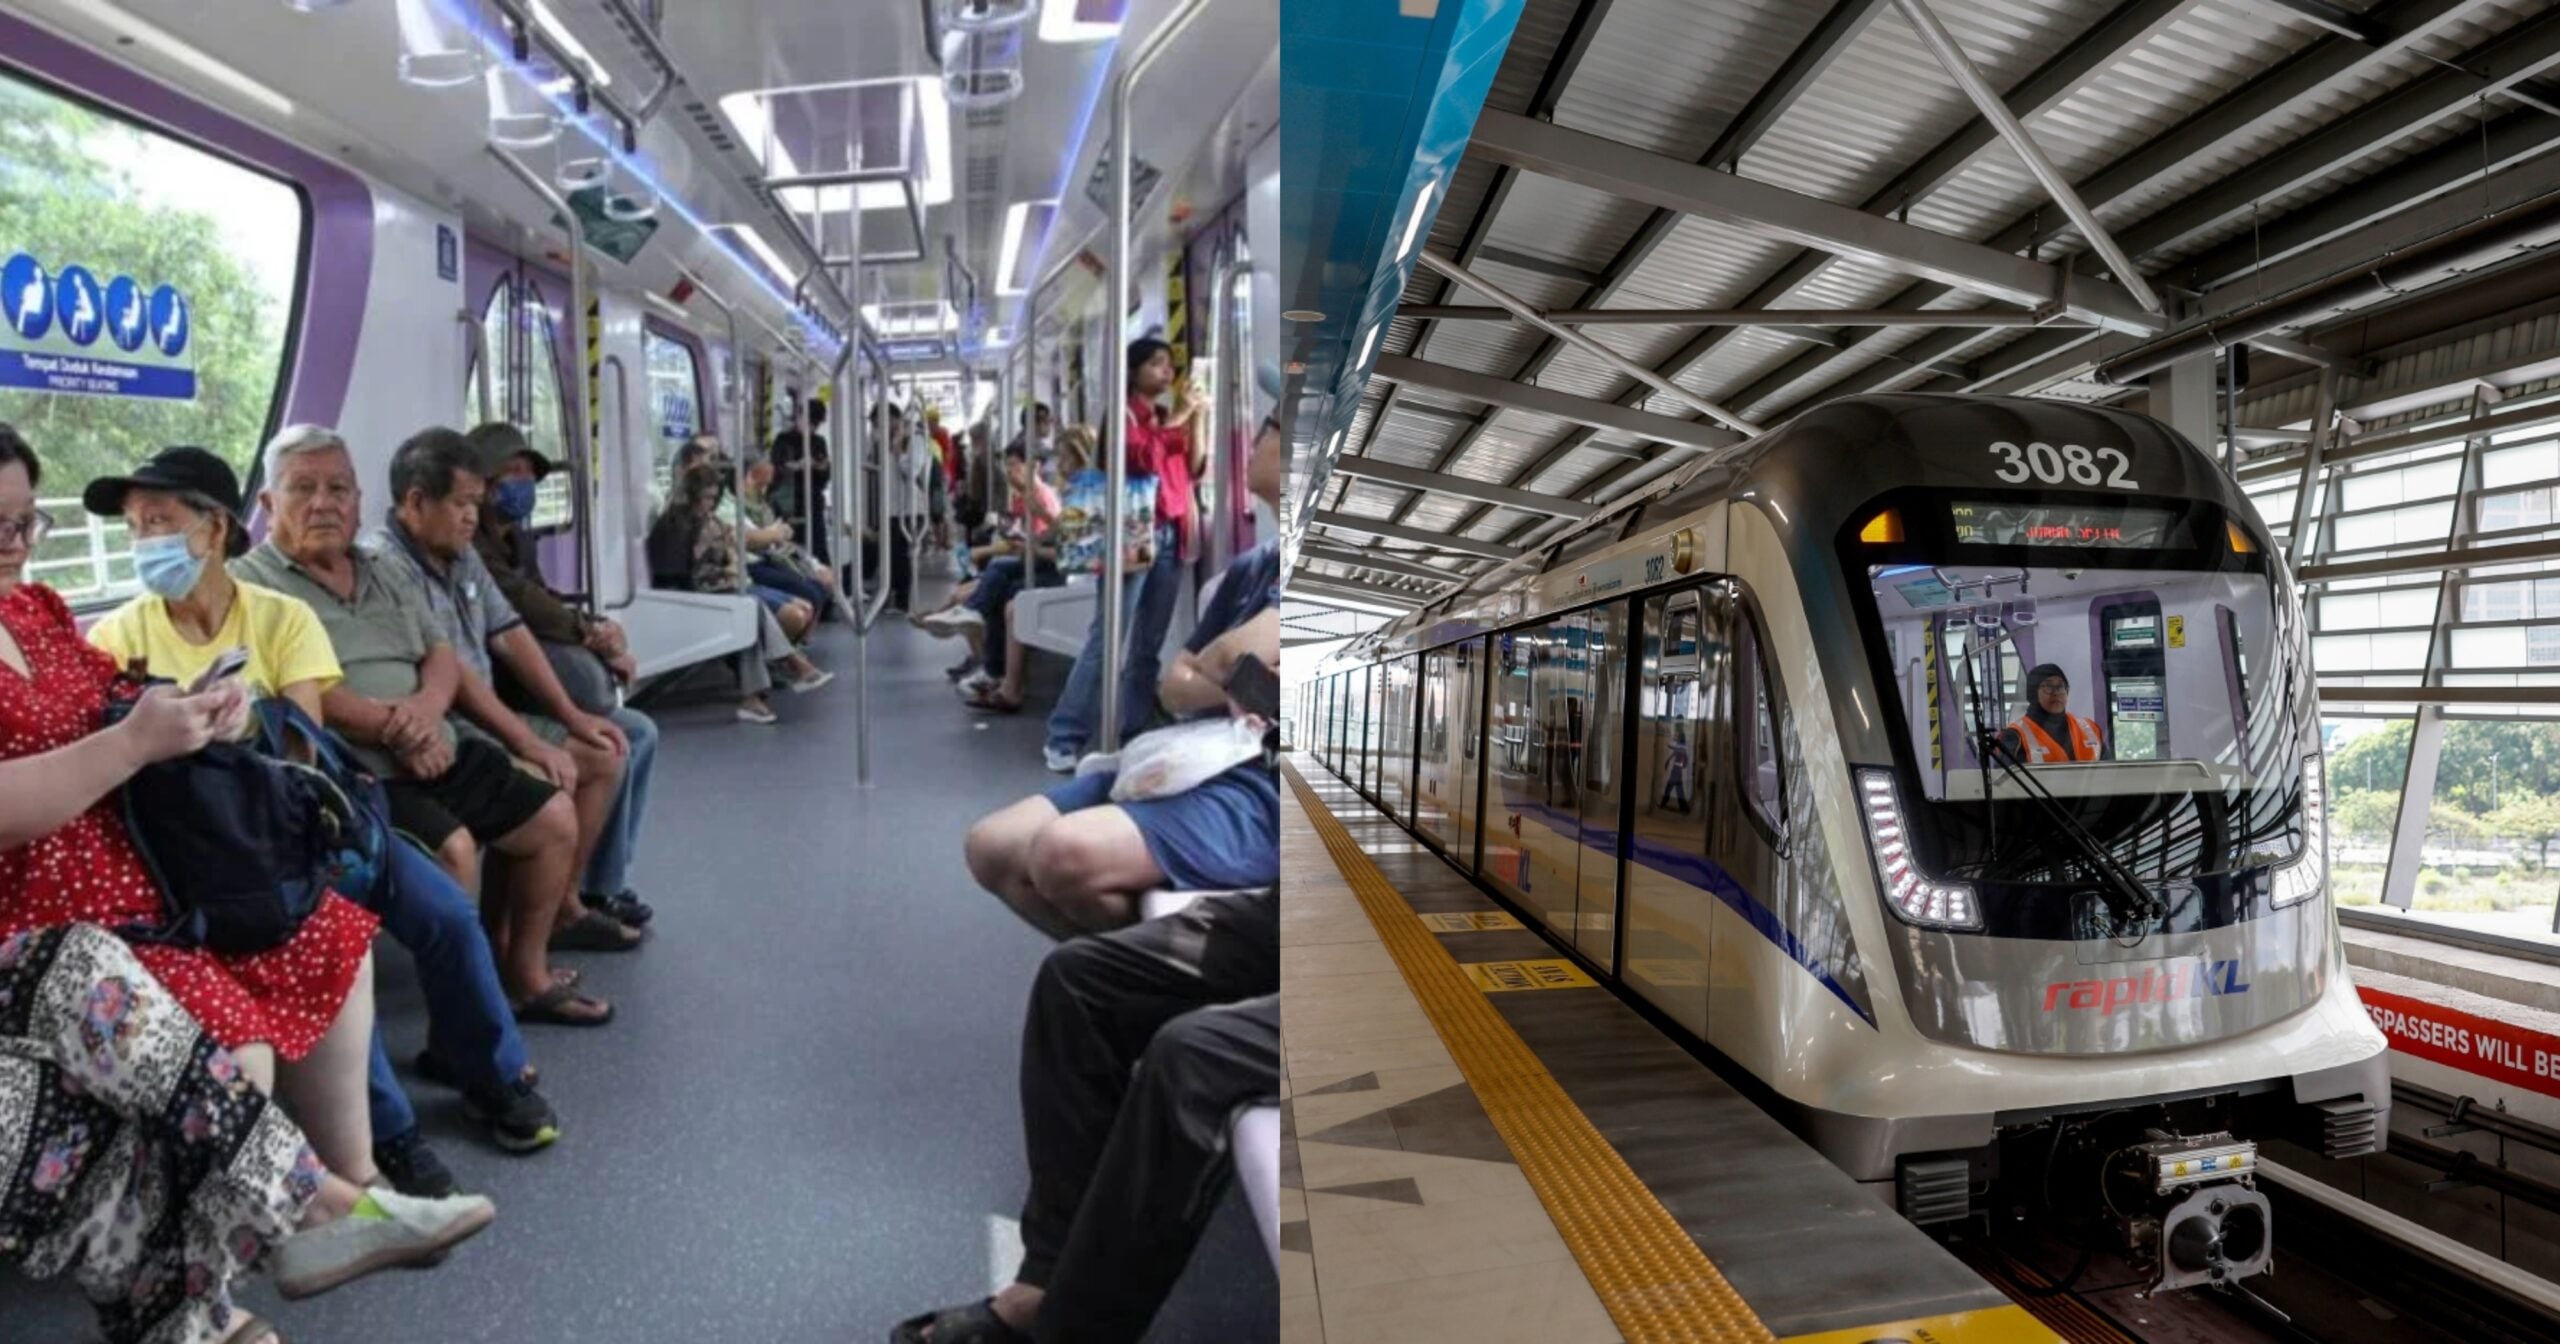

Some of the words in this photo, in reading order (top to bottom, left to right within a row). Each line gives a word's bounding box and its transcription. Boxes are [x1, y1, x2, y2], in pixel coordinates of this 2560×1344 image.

[1989, 441, 2140, 490] 3082
[2474, 1033, 2528, 1072] WILL
[2534, 1049, 2560, 1081] BE
